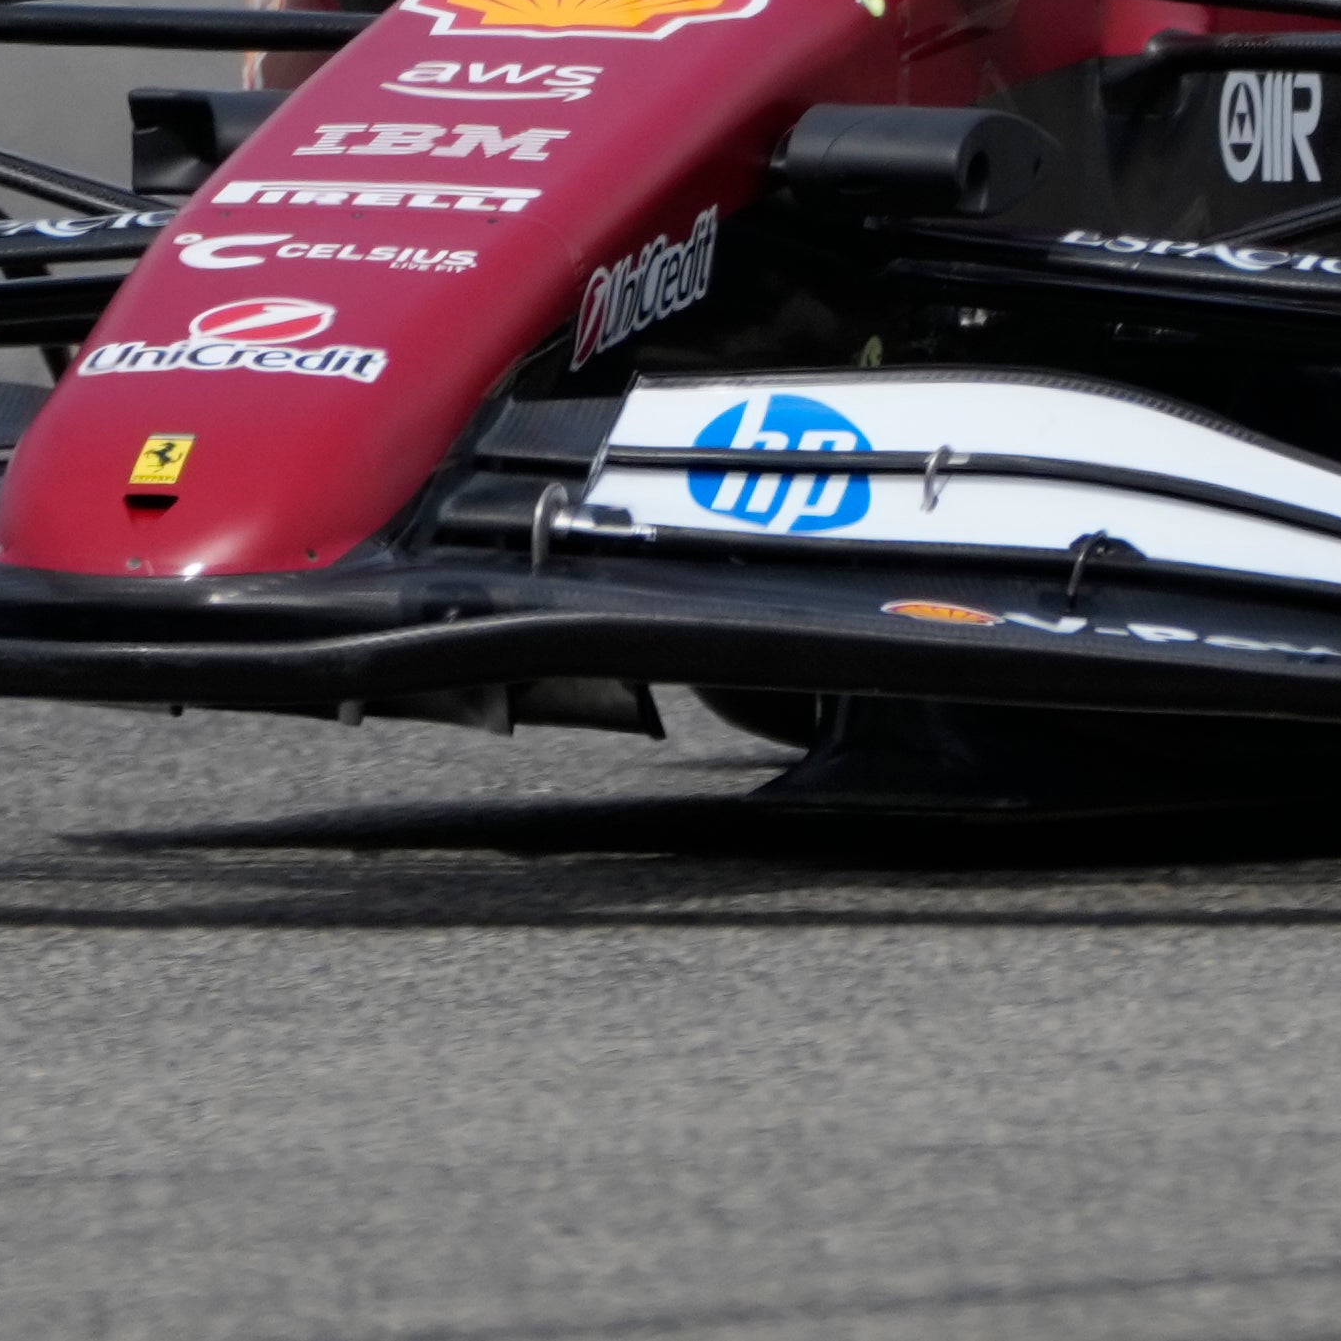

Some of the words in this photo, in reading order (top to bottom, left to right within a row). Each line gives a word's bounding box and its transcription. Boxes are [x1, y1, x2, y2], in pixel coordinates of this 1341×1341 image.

[398, 61, 604, 87] aws
[292, 122, 572, 161] IBM
[211, 181, 543, 212] PIRELLI
[275, 243, 479, 266] CELSIUS
[388, 261, 430, 271] LIVE
[600, 205, 718, 354] UniCredit
[80, 342, 389, 384] UniCredit
[711, 394, 858, 534] hp
